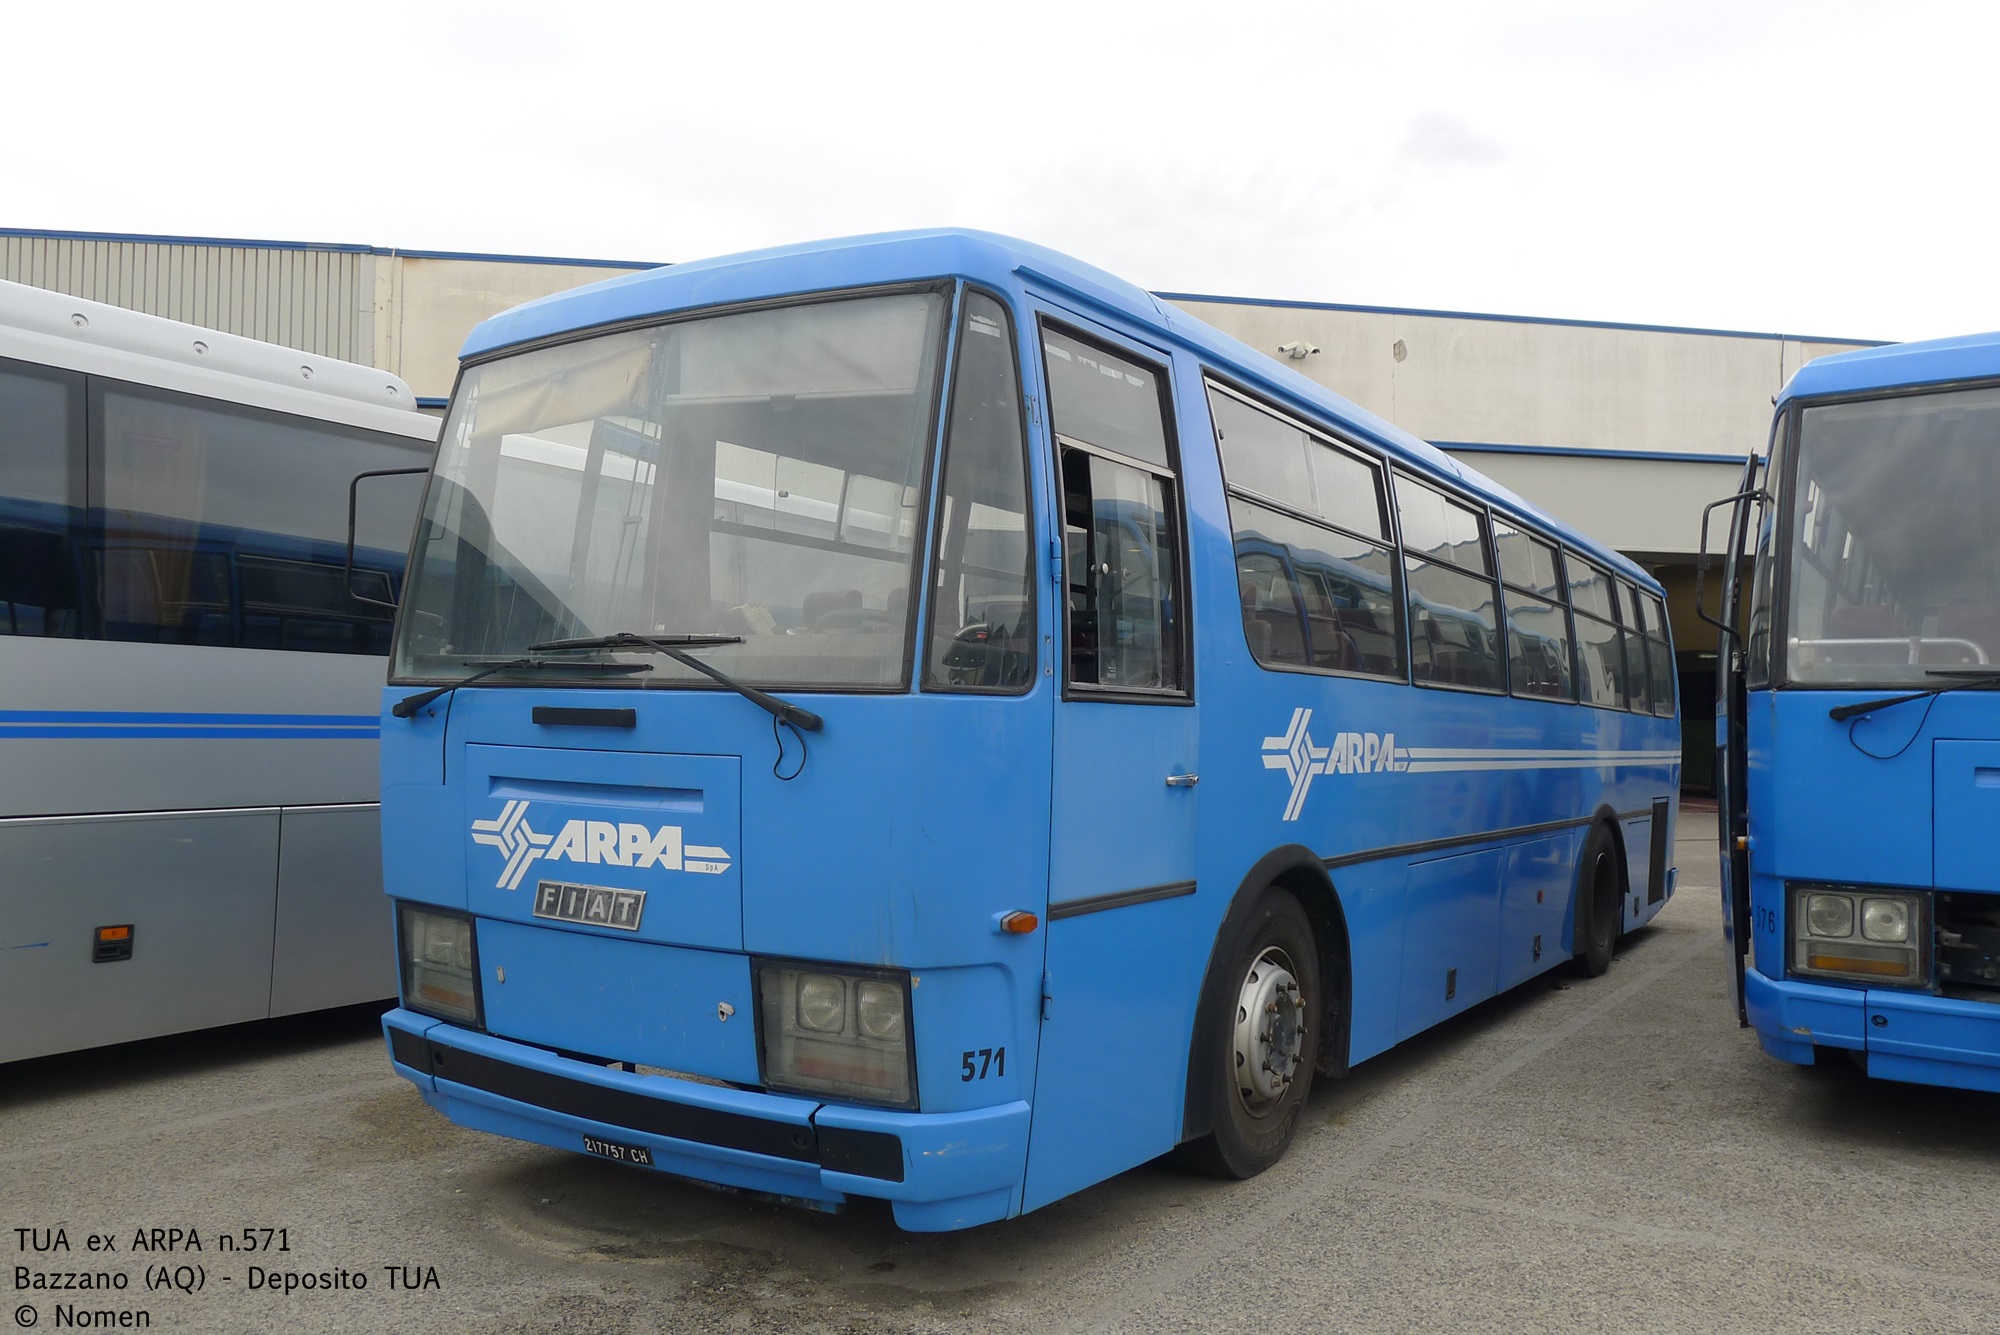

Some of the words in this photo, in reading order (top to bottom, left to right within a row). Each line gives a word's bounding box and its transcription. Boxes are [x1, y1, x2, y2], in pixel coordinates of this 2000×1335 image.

[1325, 732, 1394, 774] ARPA
[545, 819, 682, 870] ARPA
[705, 863, 719, 872] SpA
[541, 887, 635, 922] FIAT
[961, 1046, 1005, 1083] 571
[584, 1138, 625, 1160] 217757
[630, 1149, 649, 1164] CH
